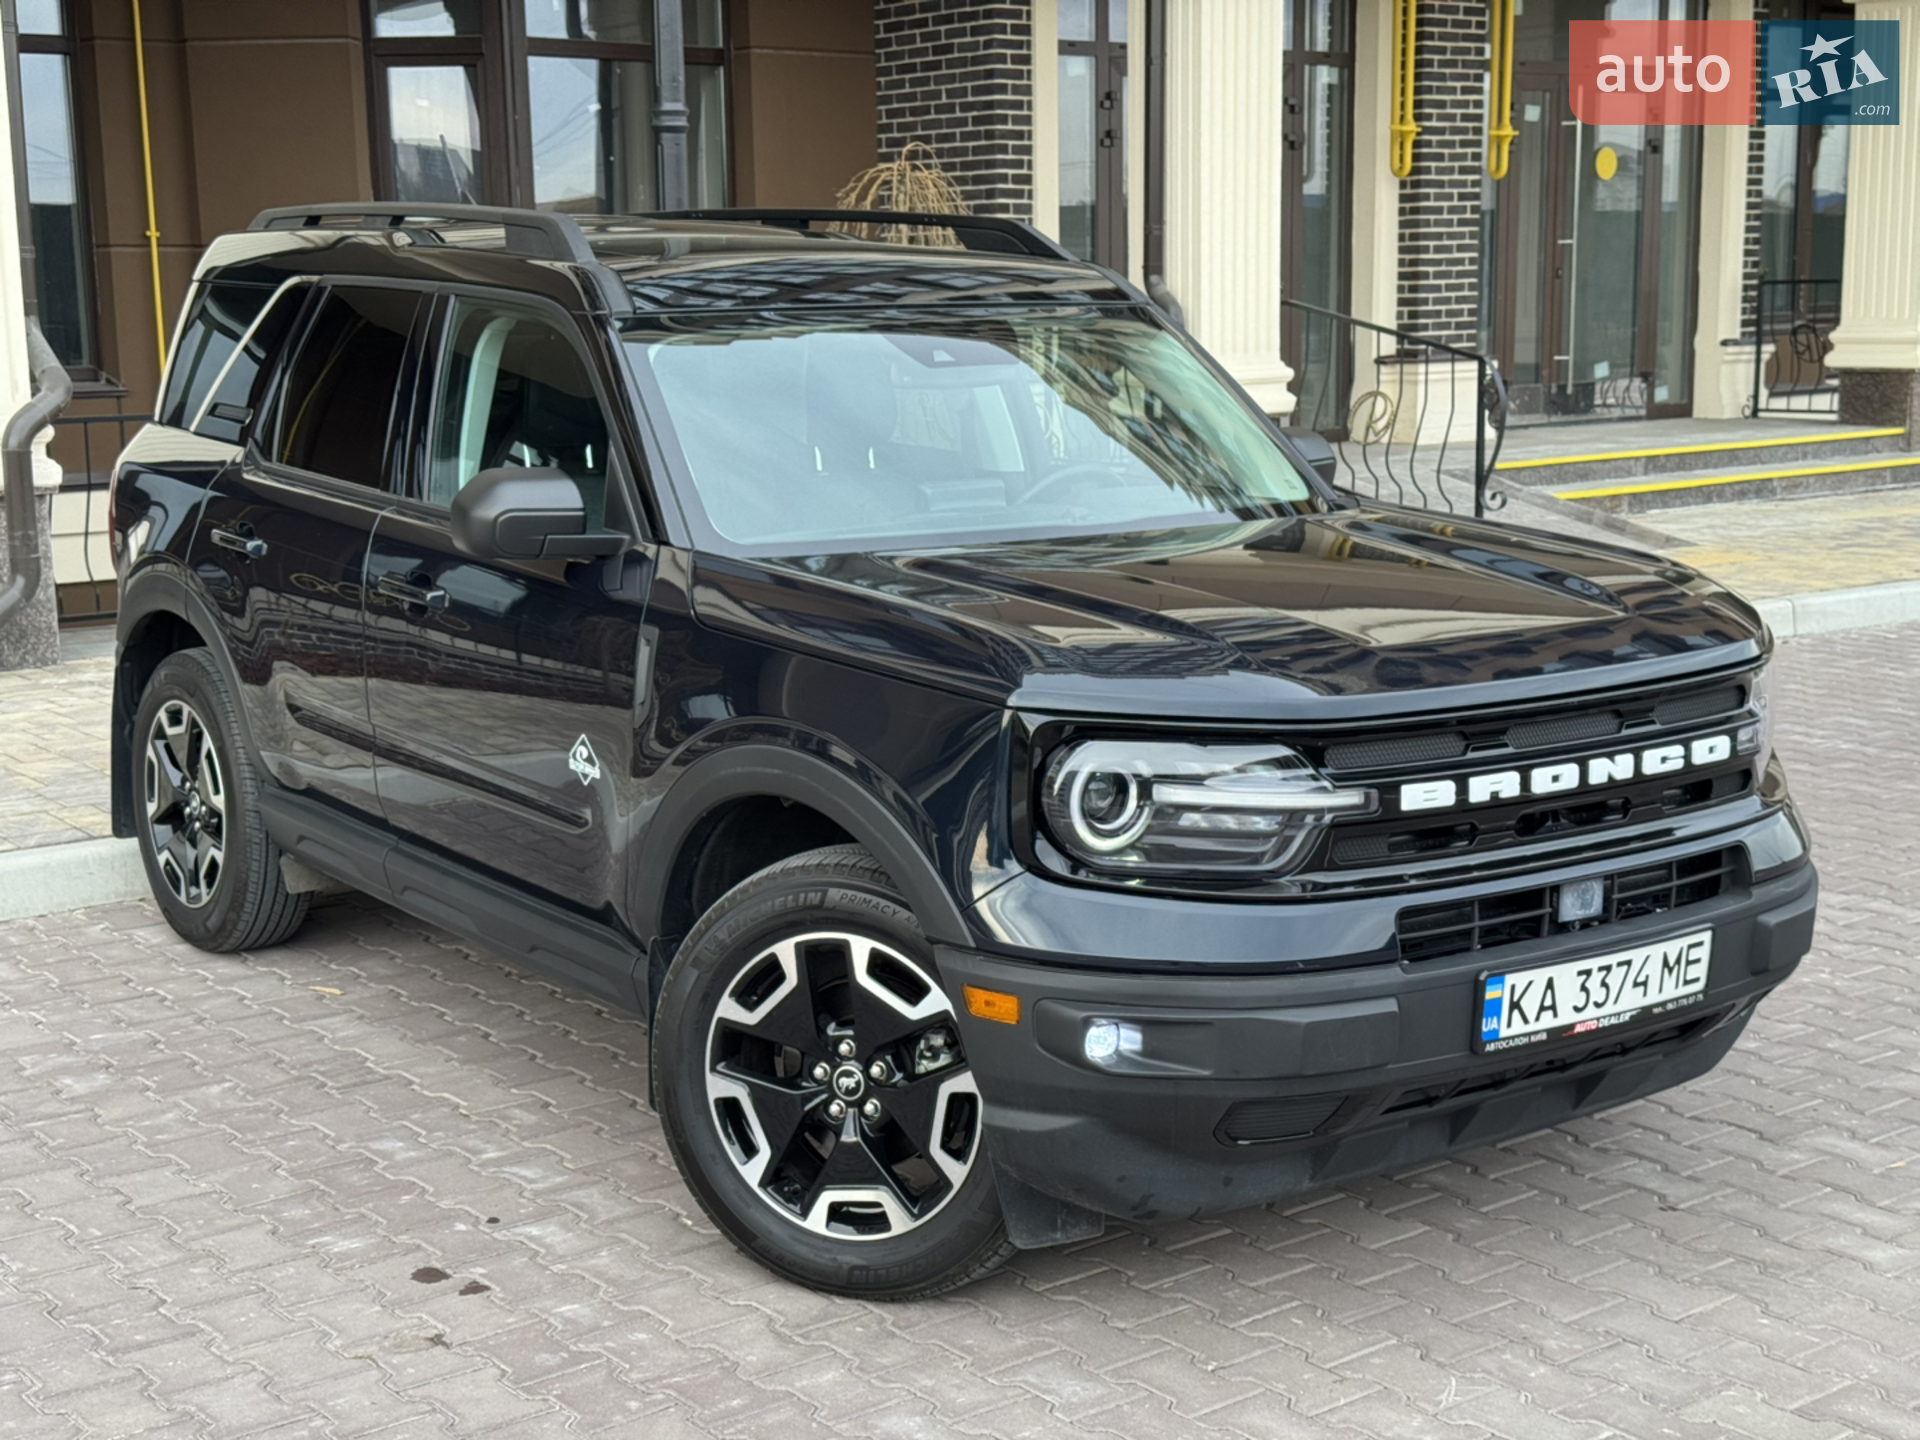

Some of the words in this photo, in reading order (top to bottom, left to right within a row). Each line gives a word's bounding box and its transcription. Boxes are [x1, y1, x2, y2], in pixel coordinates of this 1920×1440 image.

[1400, 735, 1732, 812] BRONCO
[726, 891, 823, 938] MICHELIN
[838, 892, 902, 918] PRIMACY
[1506, 976, 1559, 1029] KA
[1572, 954, 1652, 1014] 3374
[1658, 940, 1705, 995] ME
[1482, 1015, 1499, 1033] UA
[1574, 1018, 1599, 1034] AUTO
[1599, 1011, 1632, 1028] DEALER
